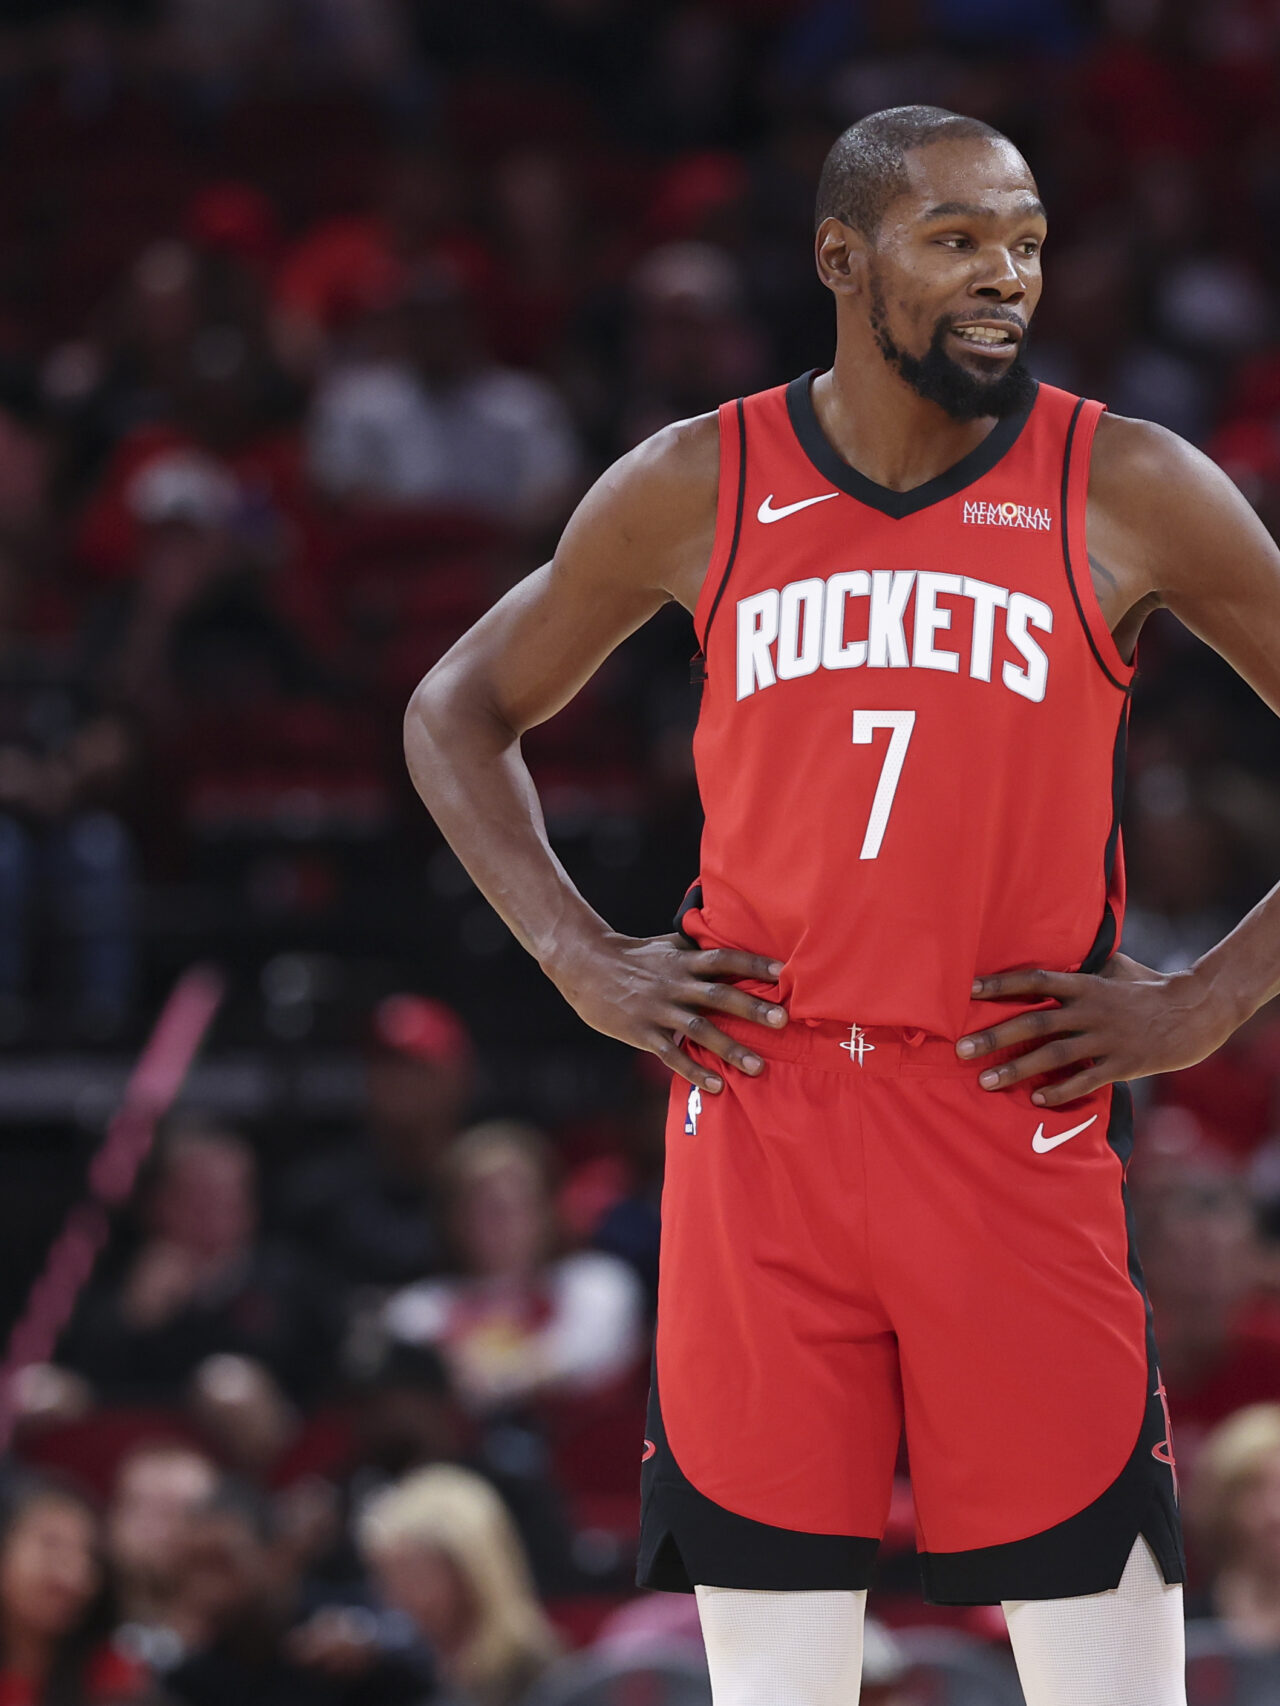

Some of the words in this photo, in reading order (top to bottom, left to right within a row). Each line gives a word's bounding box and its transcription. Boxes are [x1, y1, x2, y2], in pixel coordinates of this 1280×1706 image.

[963, 500, 1051, 520] MEMORIAL
[963, 511, 1052, 531] HERMANN
[736, 569, 1053, 703] ROCKETS
[852, 710, 916, 860] 7
